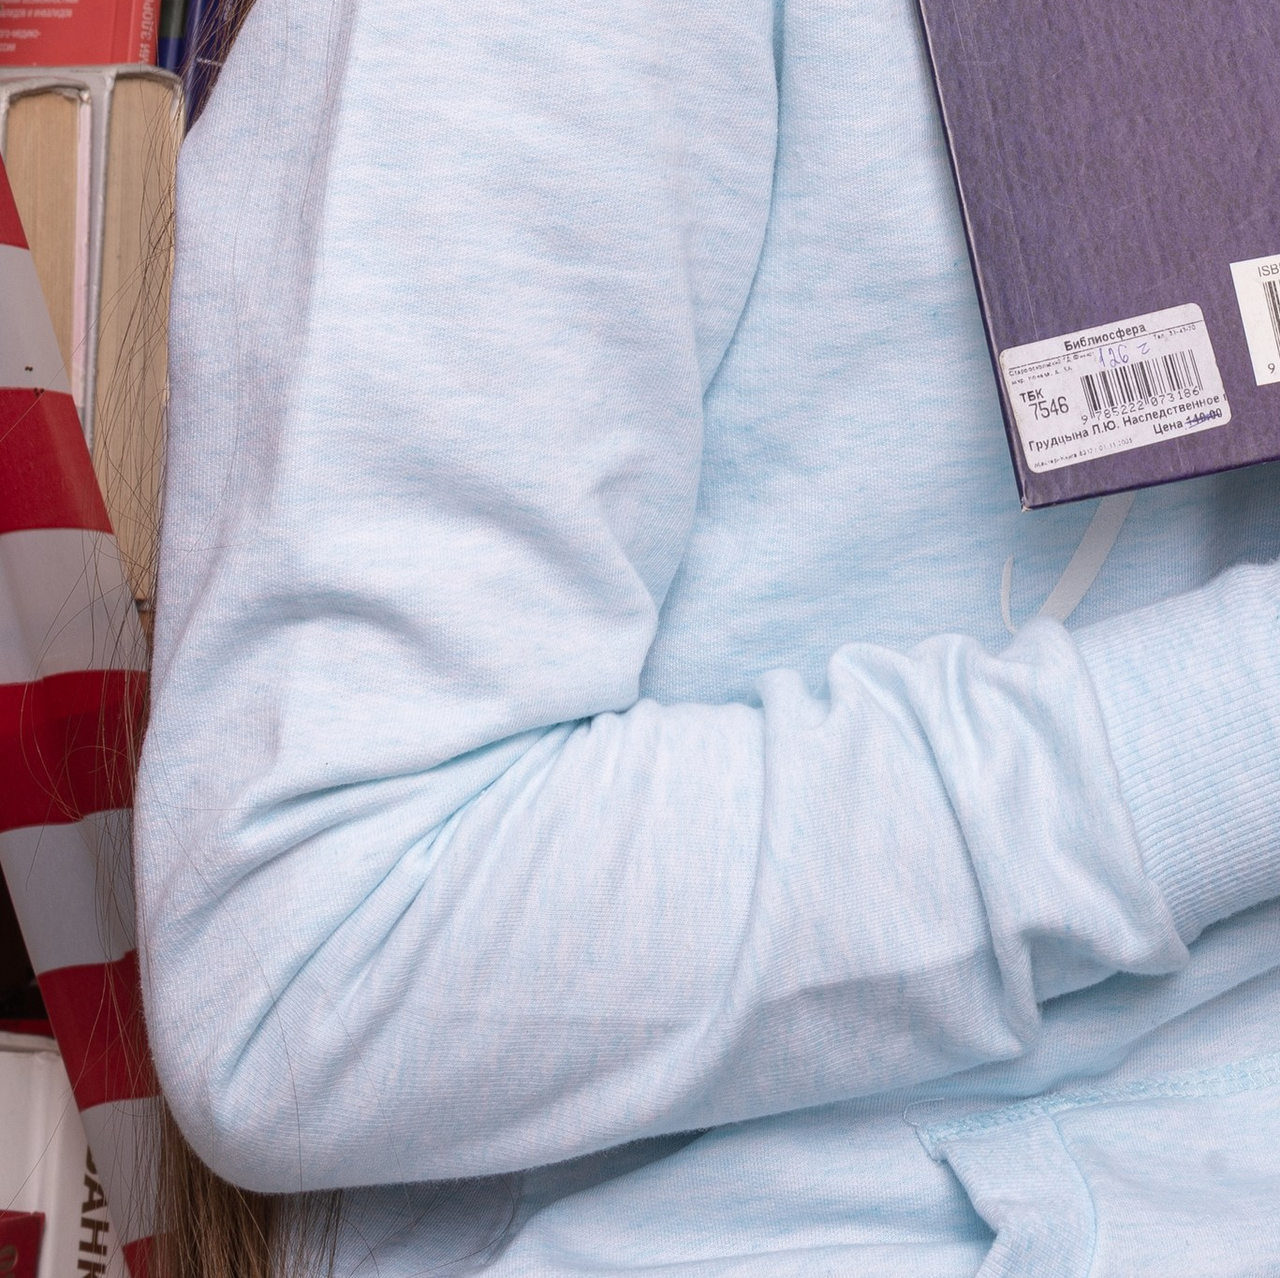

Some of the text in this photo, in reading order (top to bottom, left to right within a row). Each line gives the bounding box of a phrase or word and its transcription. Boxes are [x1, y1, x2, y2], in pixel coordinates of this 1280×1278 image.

[1064, 323, 1147, 352] Библиосфера
[1267, 362, 1276, 374] 9
[1019, 387, 1044, 404] ТБК
[1028, 395, 1070, 421] 7546
[1028, 428, 1090, 453] Грудцына
[1122, 395, 1220, 428] Наследственное
[1081, 414, 1088, 425] 9
[1152, 420, 1184, 436] Цена
